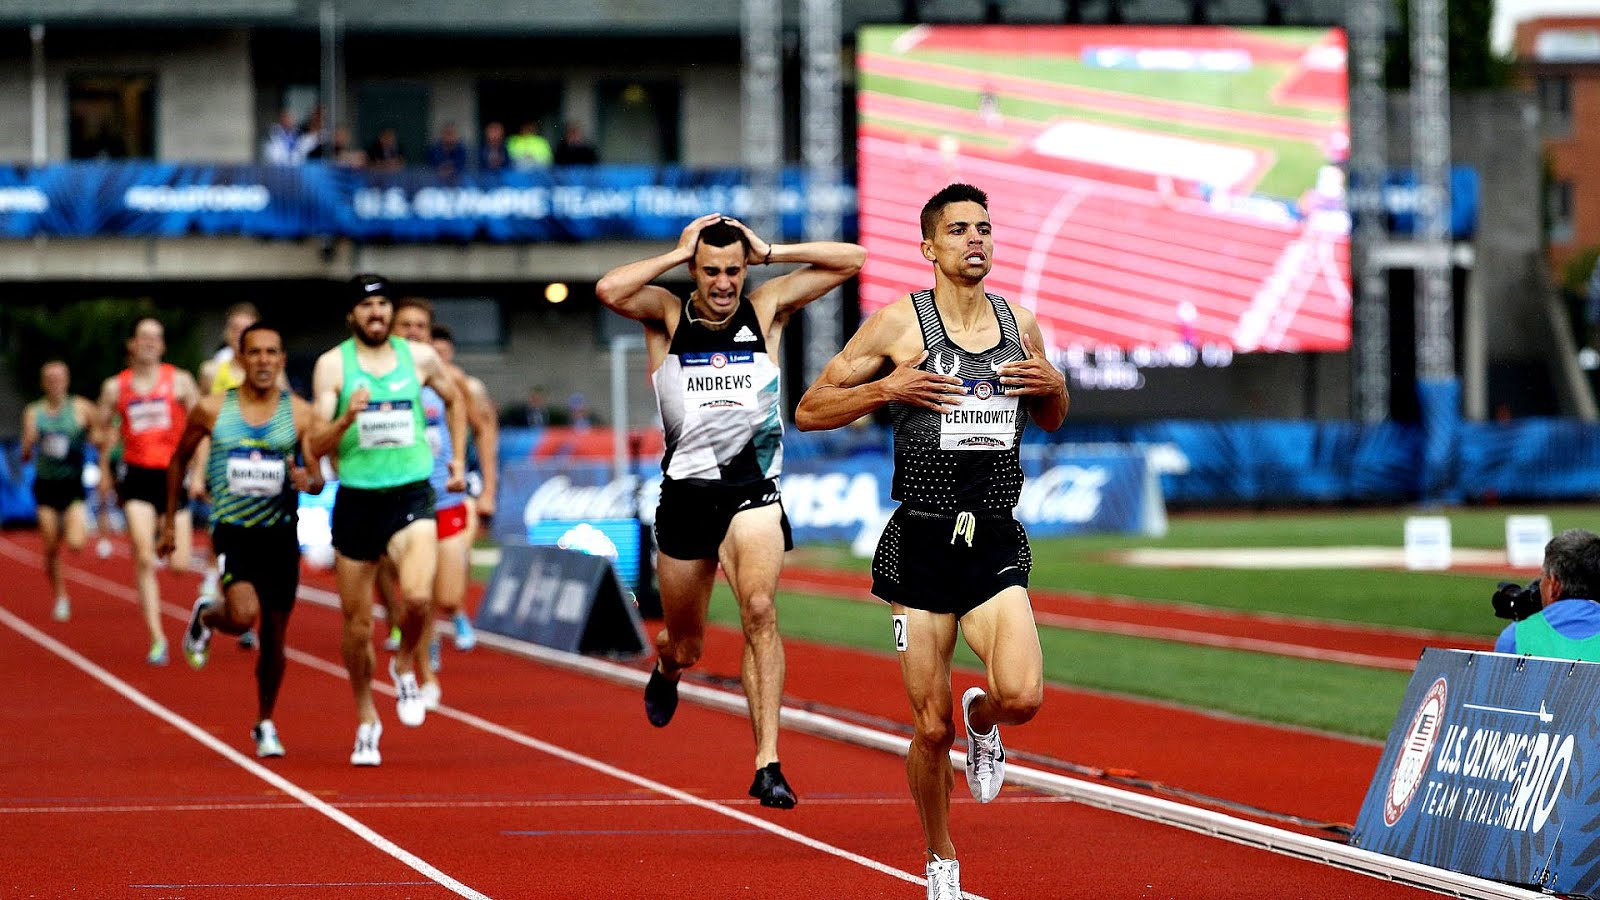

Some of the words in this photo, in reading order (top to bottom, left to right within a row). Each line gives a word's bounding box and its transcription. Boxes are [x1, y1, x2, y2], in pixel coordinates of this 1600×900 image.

[687, 375, 752, 392] ANDREWS
[945, 409, 1015, 424] CENTROWITZ
[1437, 724, 1468, 775] U.S.
[1463, 728, 1528, 783] OLYMPIC
[1421, 781, 1461, 819] TEAM
[1459, 787, 1508, 827] TRIALS
[1506, 732, 1575, 834] RIO
